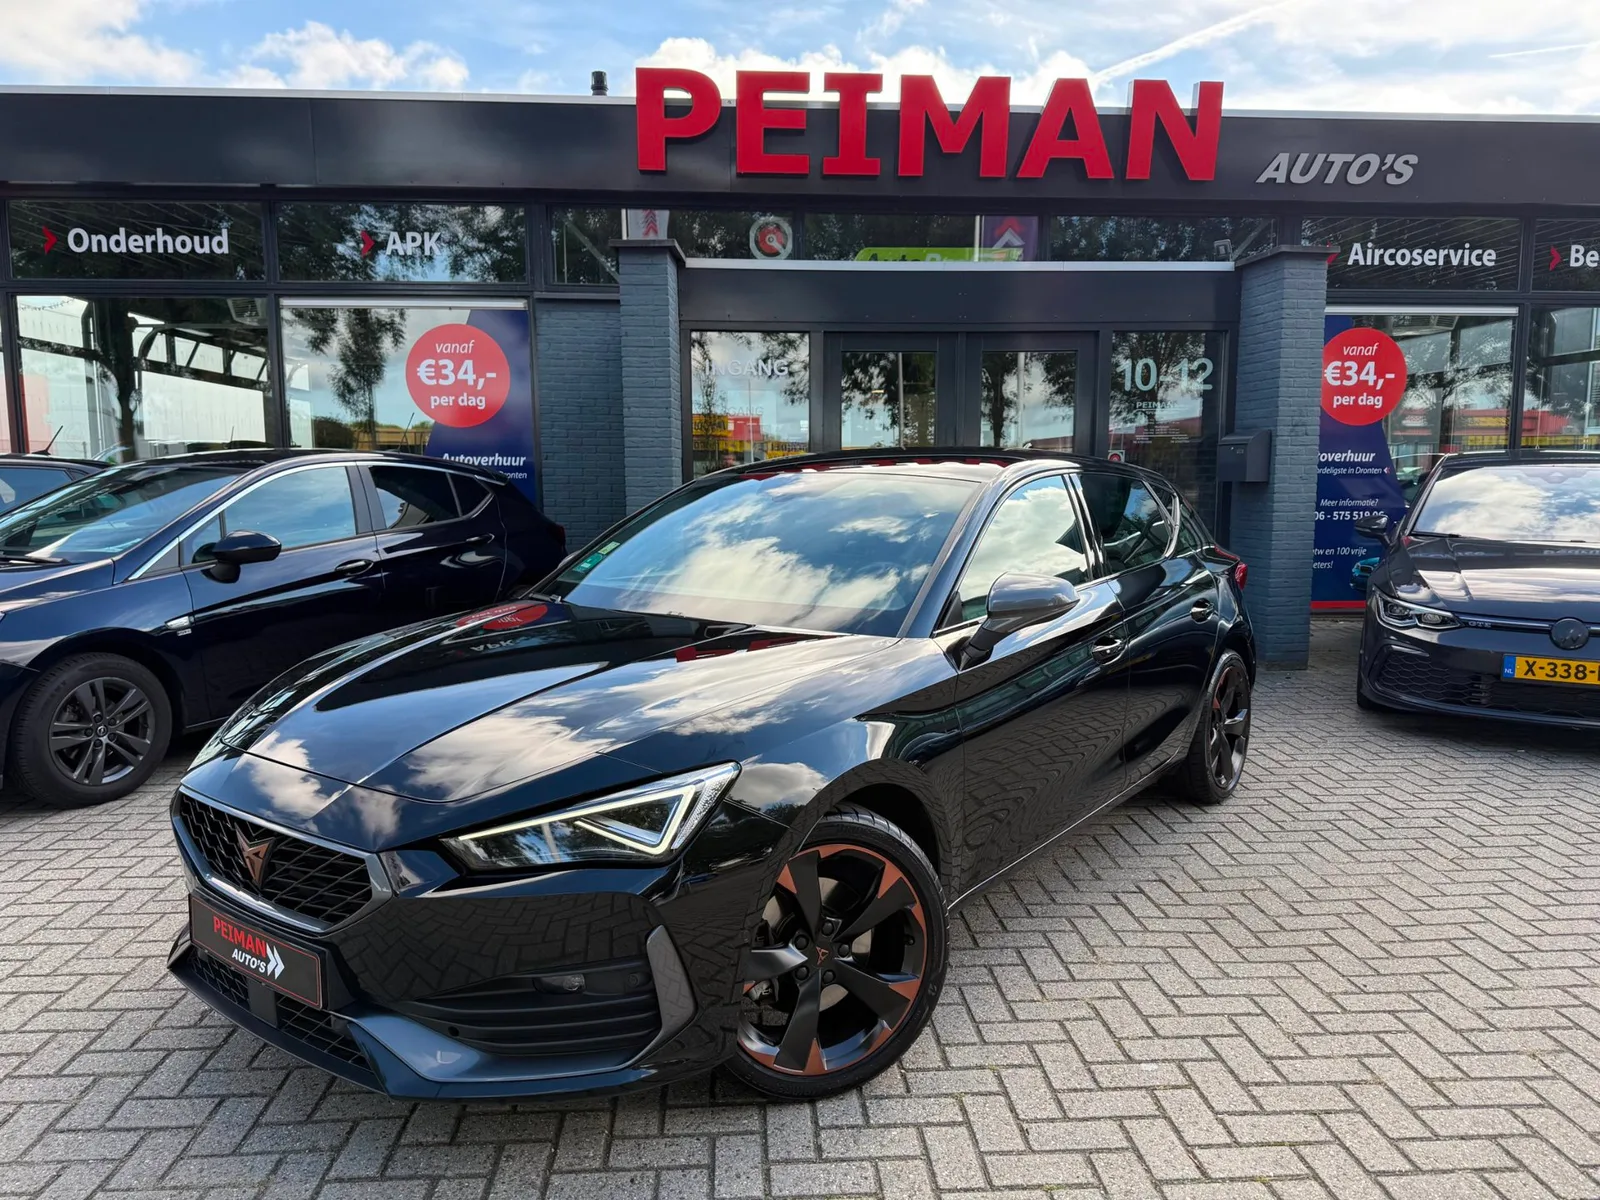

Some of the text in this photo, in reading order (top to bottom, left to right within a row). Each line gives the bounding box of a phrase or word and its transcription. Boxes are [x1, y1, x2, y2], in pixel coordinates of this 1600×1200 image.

[635, 67, 1223, 182] PEIMAN
[1256, 152, 1419, 186] AUTO'S
[67, 227, 230, 255] Onderhoud
[385, 231, 442, 256] APK
[1347, 242, 1497, 267] Aircoservice
[1569, 244, 1600, 268] Be
[435, 339, 475, 354] vanaf
[1342, 342, 1380, 356] vanaf
[416, 359, 497, 390] €34,-
[704, 359, 789, 376] INGANG
[1324, 361, 1396, 390] €34,-
[430, 393, 486, 410] per dag
[1333, 393, 1383, 408] per dag
[442, 452, 527, 467] Autoverhuur
[1318, 449, 1376, 462] overhuur
[499, 470, 528, 479] onten
[1316, 466, 1347, 475] ordeligste
[1355, 466, 1382, 474] Dronten
[1320, 498, 1379, 506] Meer informatie?
[1332, 511, 1351, 521] 575
[1352, 511, 1370, 520] 519
[1336, 547, 1350, 555] 100
[1350, 547, 1367, 556] vrije
[1313, 561, 1334, 569] eters!
[1523, 660, 1600, 682] X-338-
[213, 916, 266, 957] PEIMAN
[232, 949, 266, 973] AUTO'S
